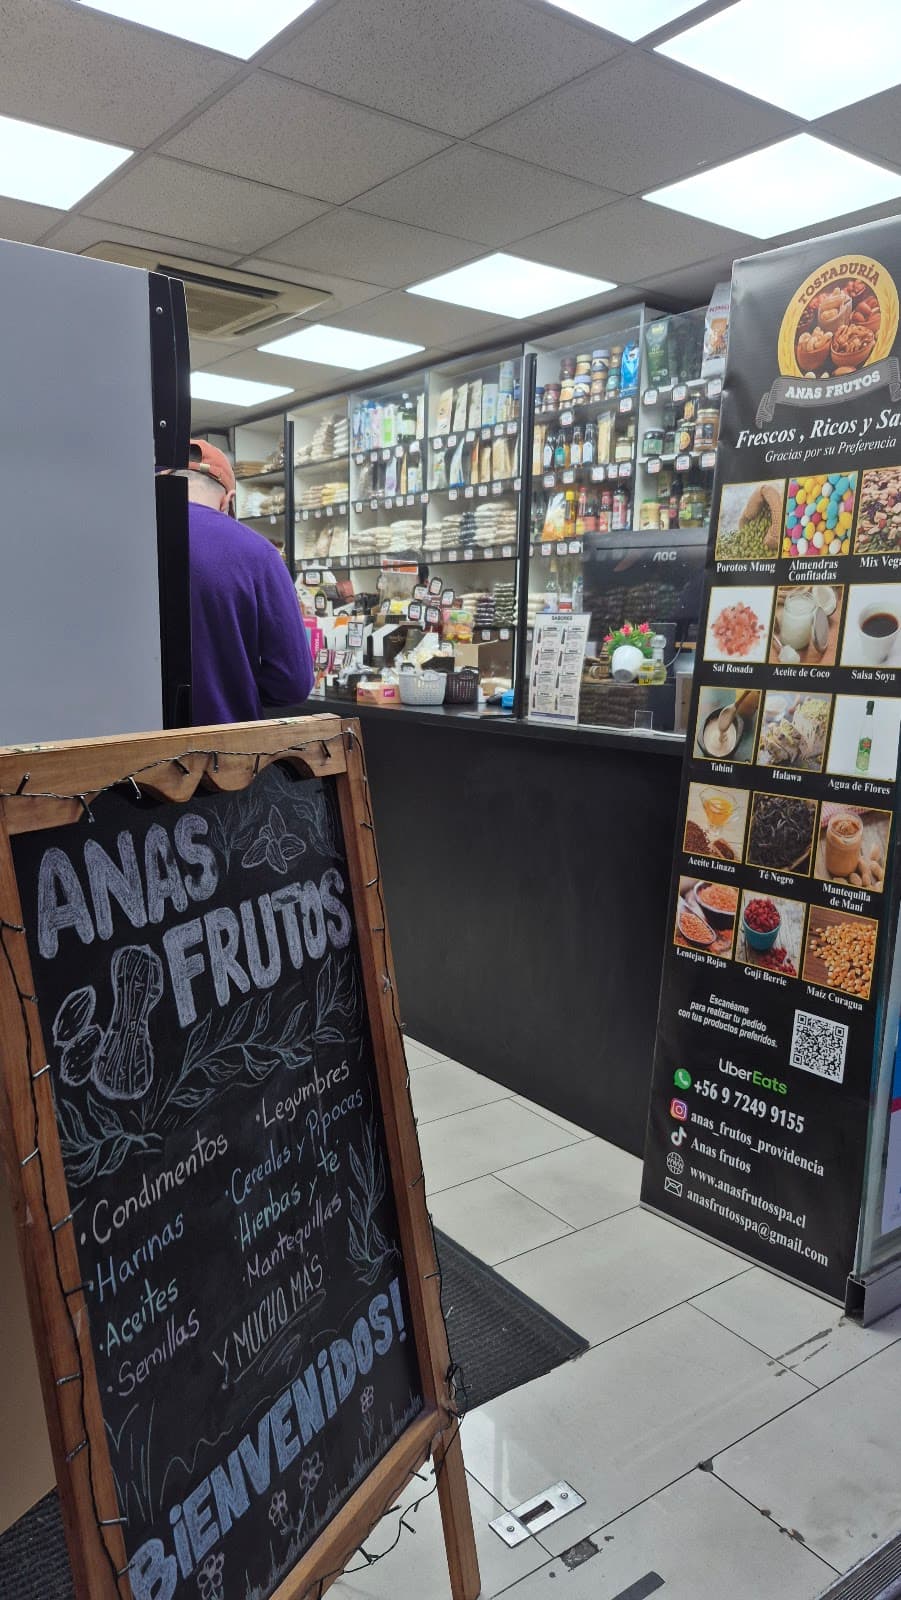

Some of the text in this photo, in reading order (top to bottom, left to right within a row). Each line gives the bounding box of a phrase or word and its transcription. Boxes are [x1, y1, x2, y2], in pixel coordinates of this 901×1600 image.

[798, 262, 880, 305] TOSTADURÍA
[785, 371, 881, 400] ANAS FRUTOS
[735, 428, 797, 448] Frescos
[810, 418, 857, 439] Ricos
[859, 416, 873, 436] y
[876, 409, 901, 429] Sa
[765, 436, 897, 463] Gracias por su Preferencia
[652, 551, 678, 562] AOC
[716, 562, 776, 574] Porotos Mung
[788, 559, 839, 571] Almendras
[859, 556, 879, 568] Mix
[788, 569, 837, 581] Confitadas
[712, 663, 753, 674] Sal Rosada
[772, 666, 830, 679] Aceite de Coco
[851, 670, 896, 683] Salsa Soya
[710, 762, 733, 774] Tahini
[772, 770, 802, 781] Halawa
[827, 779, 891, 795] Agua de Flores
[688, 855, 735, 873] Aceite Linaza
[759, 869, 794, 885] Té Negro
[37, 813, 219, 960] ANAS
[822, 883, 871, 902] Mantequilla
[830, 896, 864, 912] de Maní
[162, 867, 353, 1028] FRUTOS
[676, 947, 727, 968] Lentejas Rojas
[763, 971, 788, 987] Berrie
[690, 1000, 767, 1032] para realizar tu pedido
[709, 993, 750, 1015] Escanéame
[828, 992, 863, 1011] Curagua
[678, 1008, 778, 1048] con tus productos preferidos.
[718, 1057, 789, 1095] UberEats
[262, 1059, 350, 1128] Legumbres
[694, 1078, 806, 1134] +56 9 7249 9155
[690, 1111, 825, 1177] anas_frutos_providencia
[690, 1137, 752, 1174] Anas frutos
[91, 1129, 229, 1245] Condimentos
[231, 1139, 291, 1205] Cereales
[689, 1165, 807, 1229] www.anasfrutosspa.cl
[239, 1182, 301, 1252] Hierbas
[686, 1188, 829, 1267] anasfrutosspa@gmail.com
[244, 1193, 342, 1287] Mantequillas
[95, 1213, 185, 1302] Harinas
[107, 1278, 179, 1358] Aceites
[232, 1287, 289, 1368] MUCHO
[117, 1308, 200, 1397] Semillas
